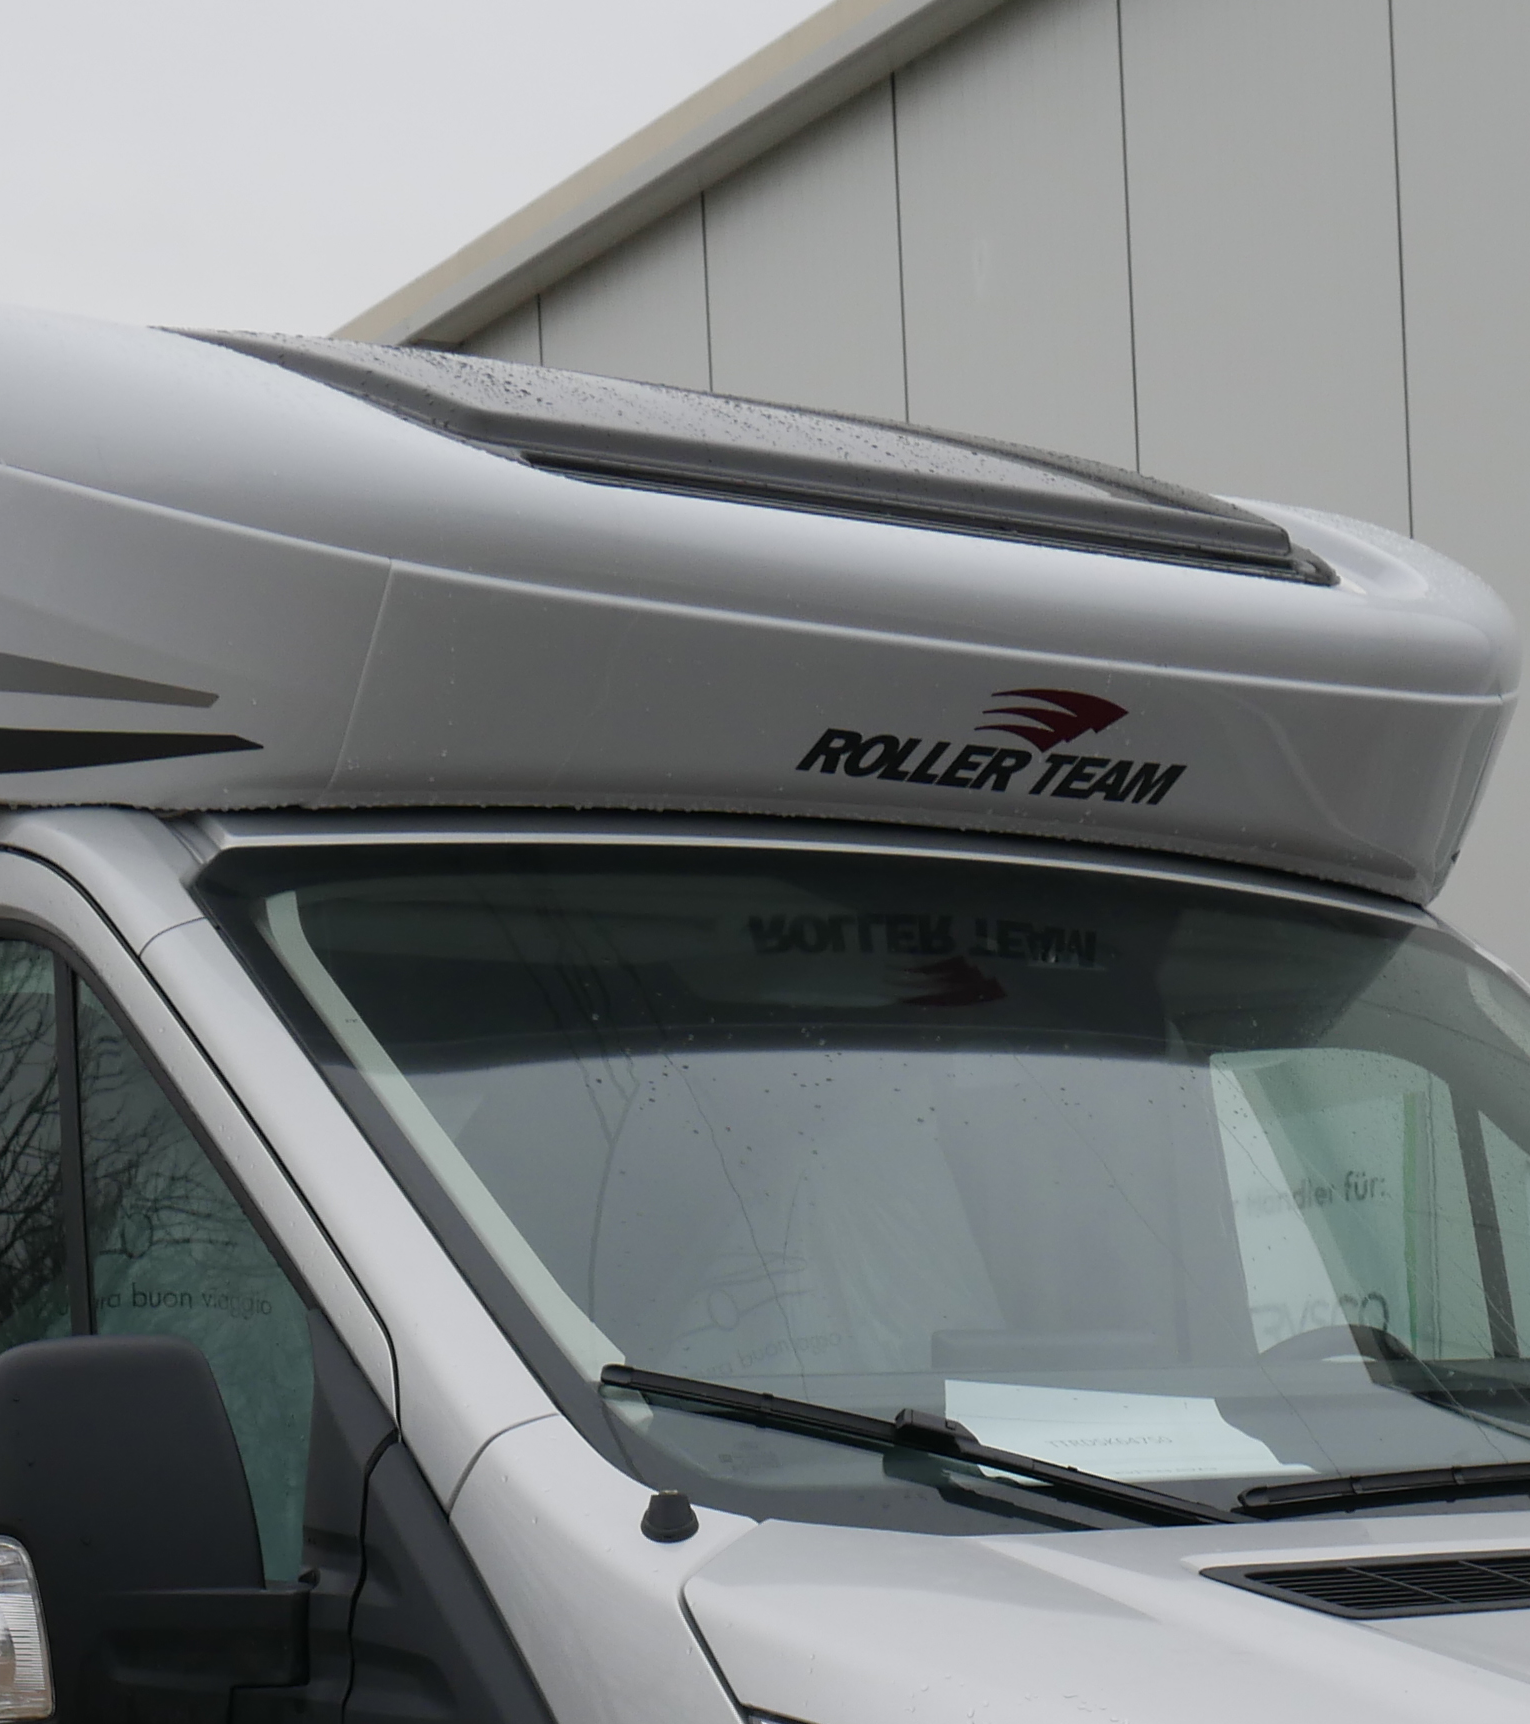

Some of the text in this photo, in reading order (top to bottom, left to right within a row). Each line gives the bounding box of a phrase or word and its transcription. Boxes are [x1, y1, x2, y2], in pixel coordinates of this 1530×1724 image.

[795, 728, 1187, 806] ROLLER TEAM
[131, 1281, 193, 1310] buon
